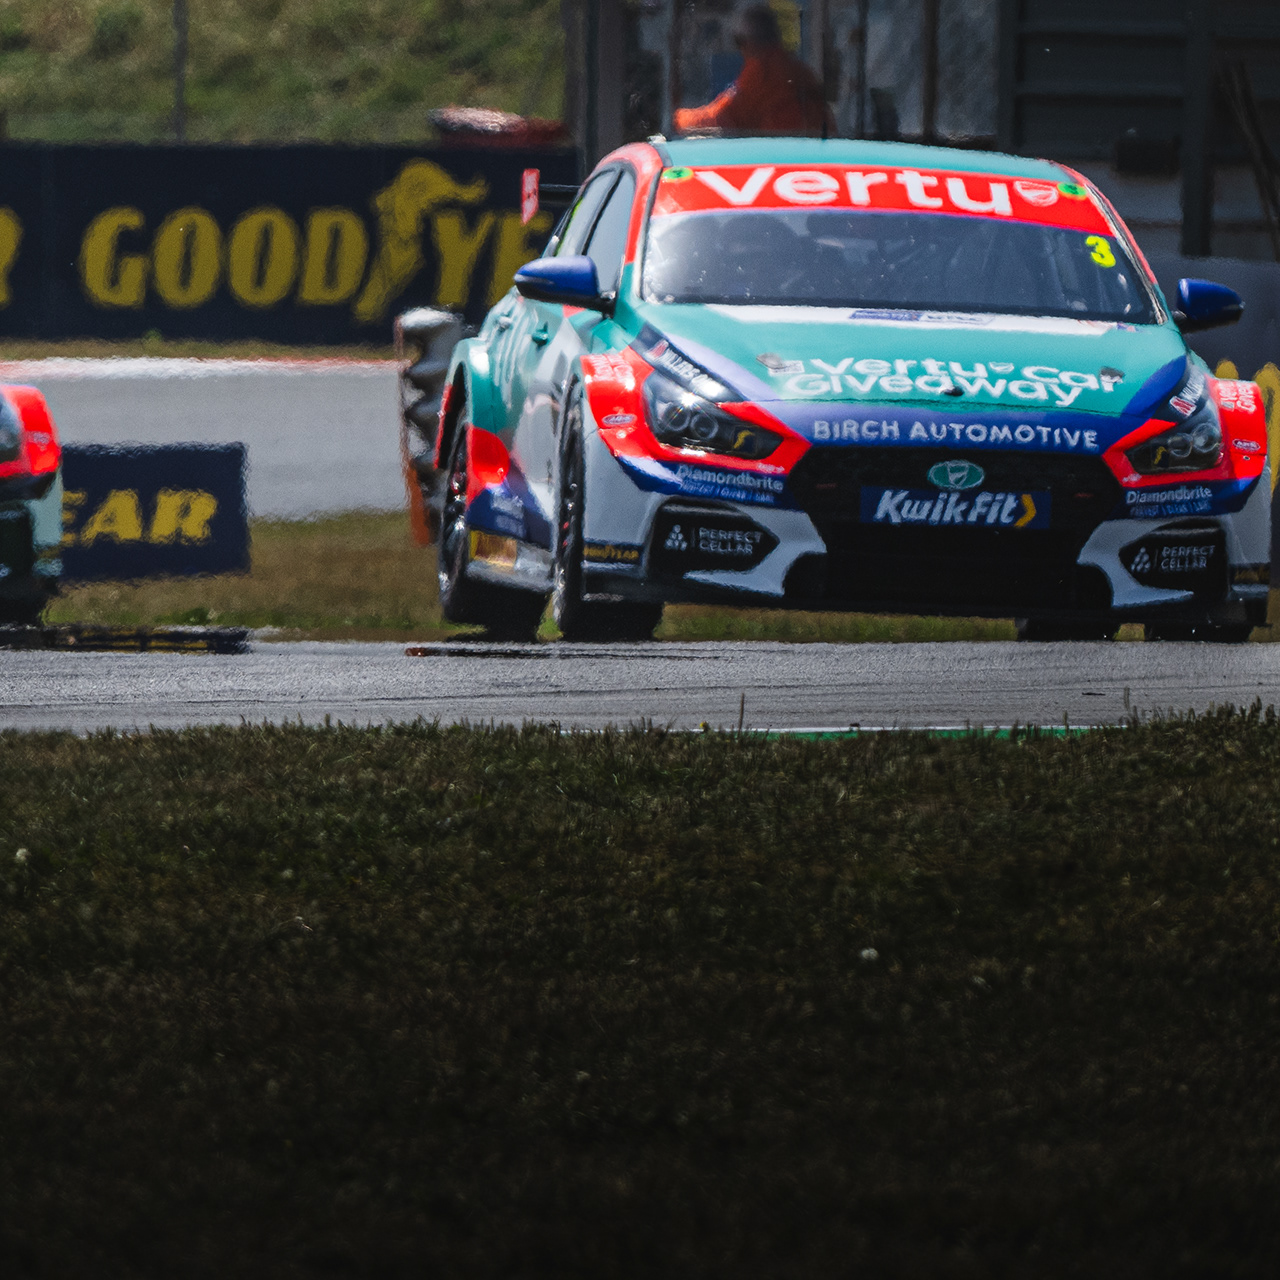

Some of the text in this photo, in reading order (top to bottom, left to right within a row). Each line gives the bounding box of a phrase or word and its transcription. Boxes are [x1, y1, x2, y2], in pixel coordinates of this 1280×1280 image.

[695, 166, 1013, 216] Vertu
[80, 206, 553, 310] GOODYE
[1086, 234, 1117, 268] 3
[783, 372, 1083, 407] Giveaway
[813, 419, 1100, 450] BIRCH AUTOMOTIVE
[676, 464, 784, 492] Diamondbrite
[1126, 485, 1213, 505] Diamondbrite
[698, 526, 763, 544] PERFECT
[699, 540, 754, 555] CELLAR
[1160, 557, 1208, 570] CELLAR
[1161, 544, 1215, 558] PERFECT
